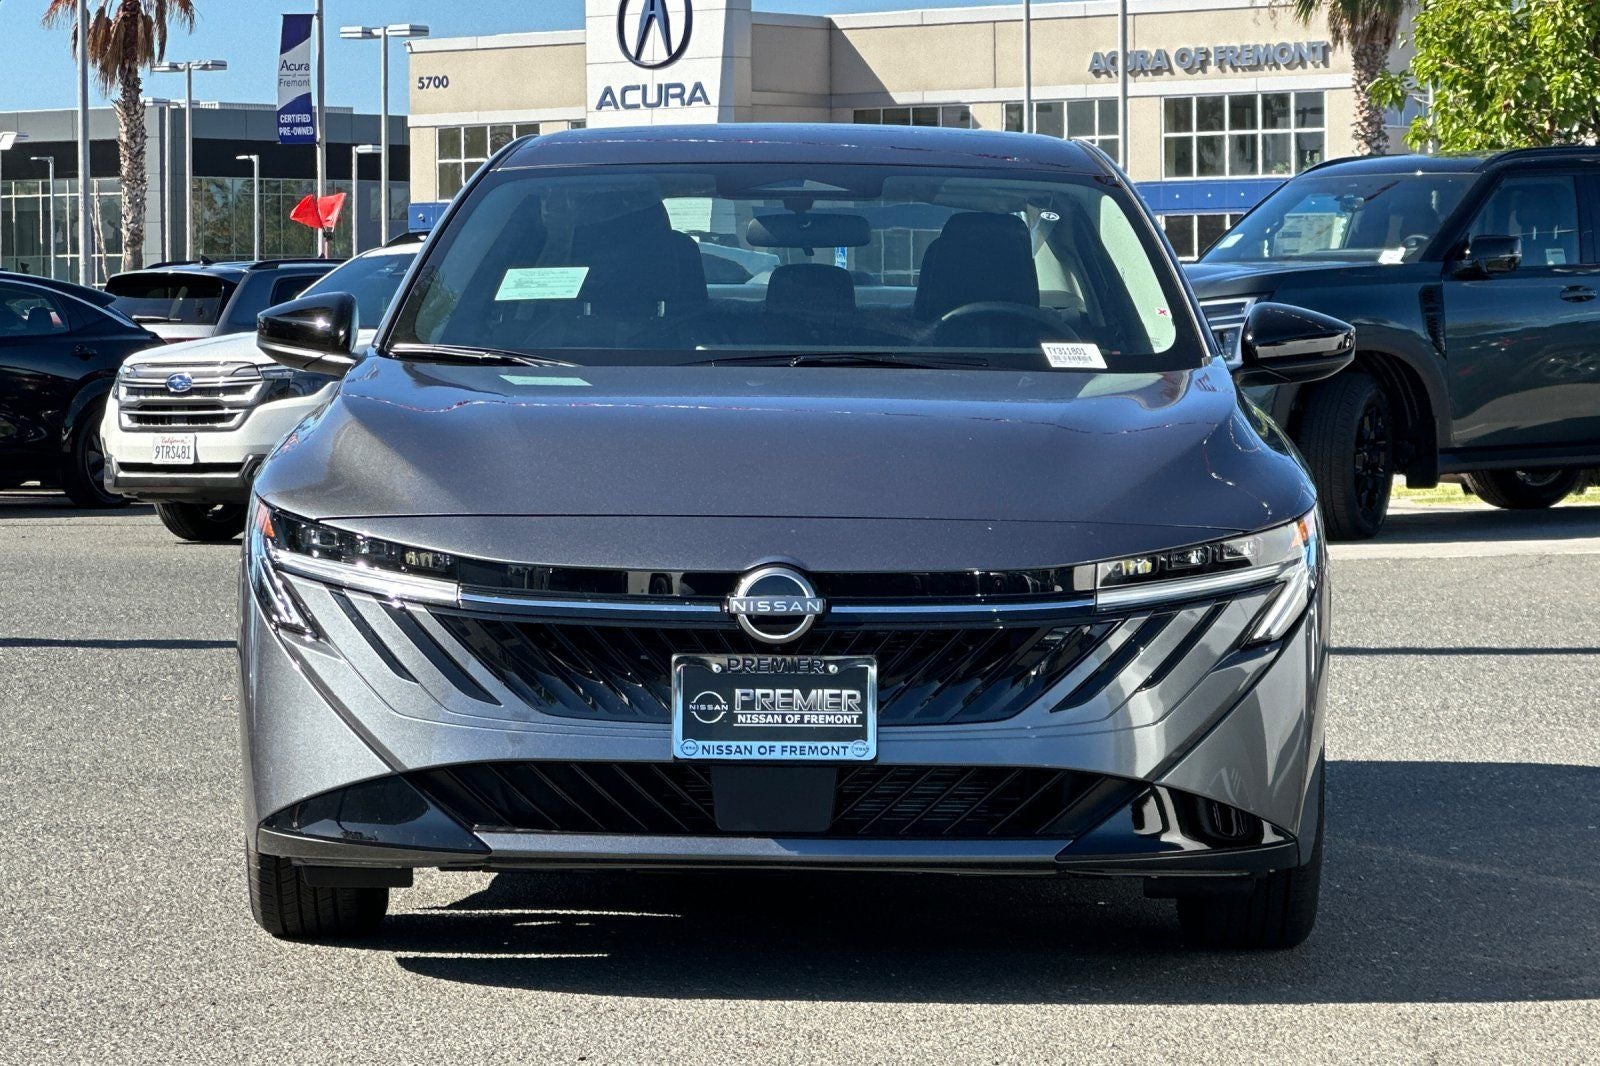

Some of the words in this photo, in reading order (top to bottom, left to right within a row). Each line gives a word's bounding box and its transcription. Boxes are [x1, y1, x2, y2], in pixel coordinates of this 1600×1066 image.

[1174, 47, 1207, 69] OF
[1213, 41, 1327, 67] FREMONT
[280, 59, 310, 72] Acura
[279, 78, 310, 87] Fremont
[418, 75, 449, 90] 5700
[595, 81, 711, 110] ACURA
[280, 113, 311, 124] CERTIFIED
[279, 126, 314, 136] PRE-OWNED
[155, 445, 191, 459] 9TRS481
[732, 600, 820, 612] NISSAN
[727, 658, 825, 674] PREMIER
[734, 688, 862, 712] PREMIER
[737, 714, 782, 724] NISSAN
[785, 714, 801, 724] OF
[804, 714, 859, 724] FREMONT
[701, 745, 753, 756] NISSAN
[757, 745, 776, 756] OF
[780, 745, 849, 756] FREMONT
